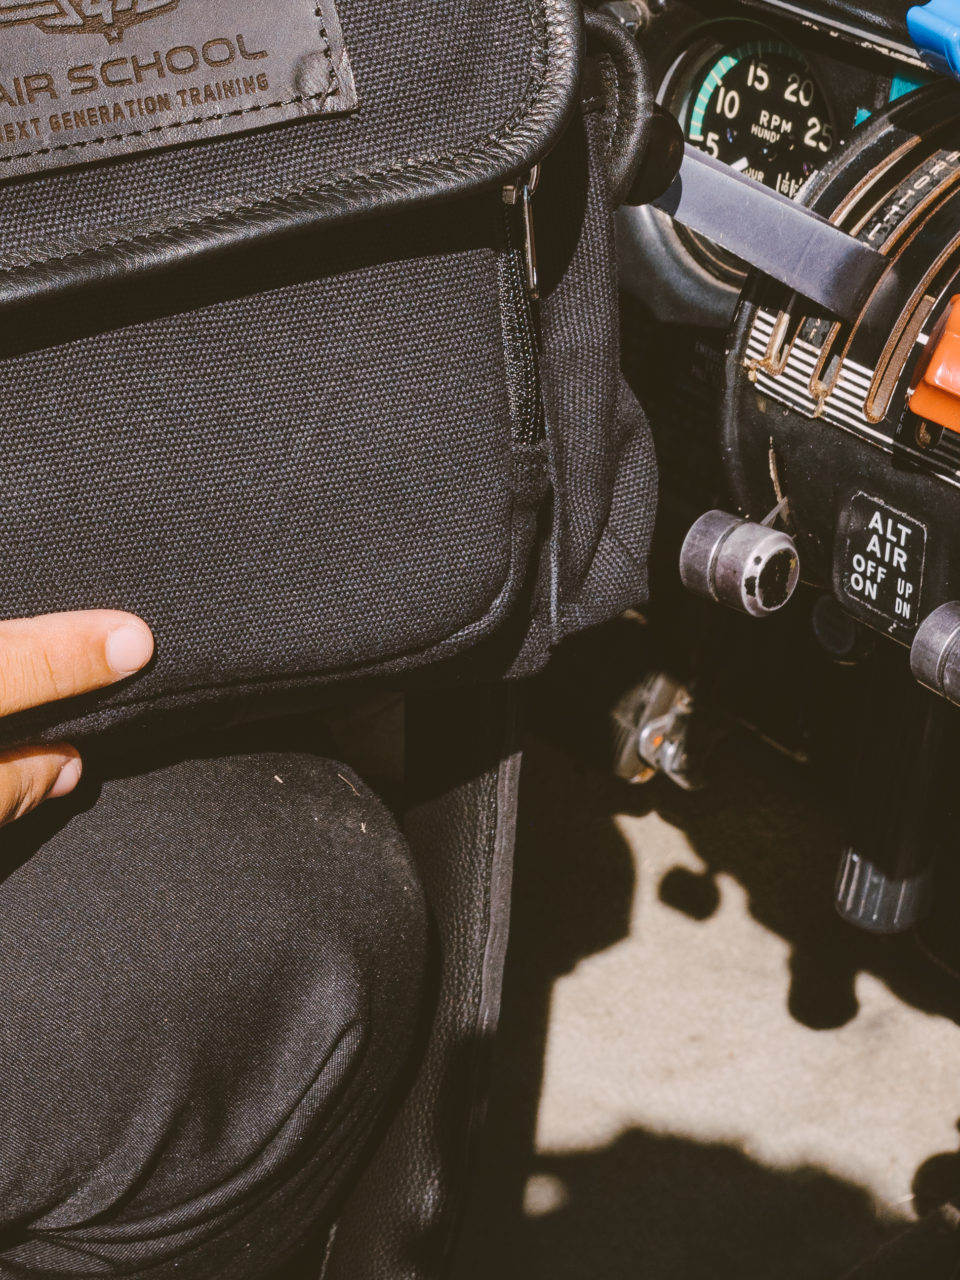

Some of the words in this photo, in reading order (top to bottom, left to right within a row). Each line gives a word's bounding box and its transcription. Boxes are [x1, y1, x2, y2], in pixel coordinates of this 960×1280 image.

[66, 33, 270, 96] SCHOOL
[748, 61, 770, 91] 15
[48, 92, 172, 135] GENERATION
[176, 72, 271, 108] TRAINING
[716, 86, 740, 119] 10
[784, 73, 814, 107] 20
[759, 109, 793, 133] RPM
[803, 117, 833, 152] 25
[868, 511, 912, 547] ALT
[866, 534, 908, 573] AIR
[852, 553, 887, 584] OFF
[896, 577, 914, 598] UP
[850, 572, 878, 601] ON
[894, 597, 911, 620] DN
